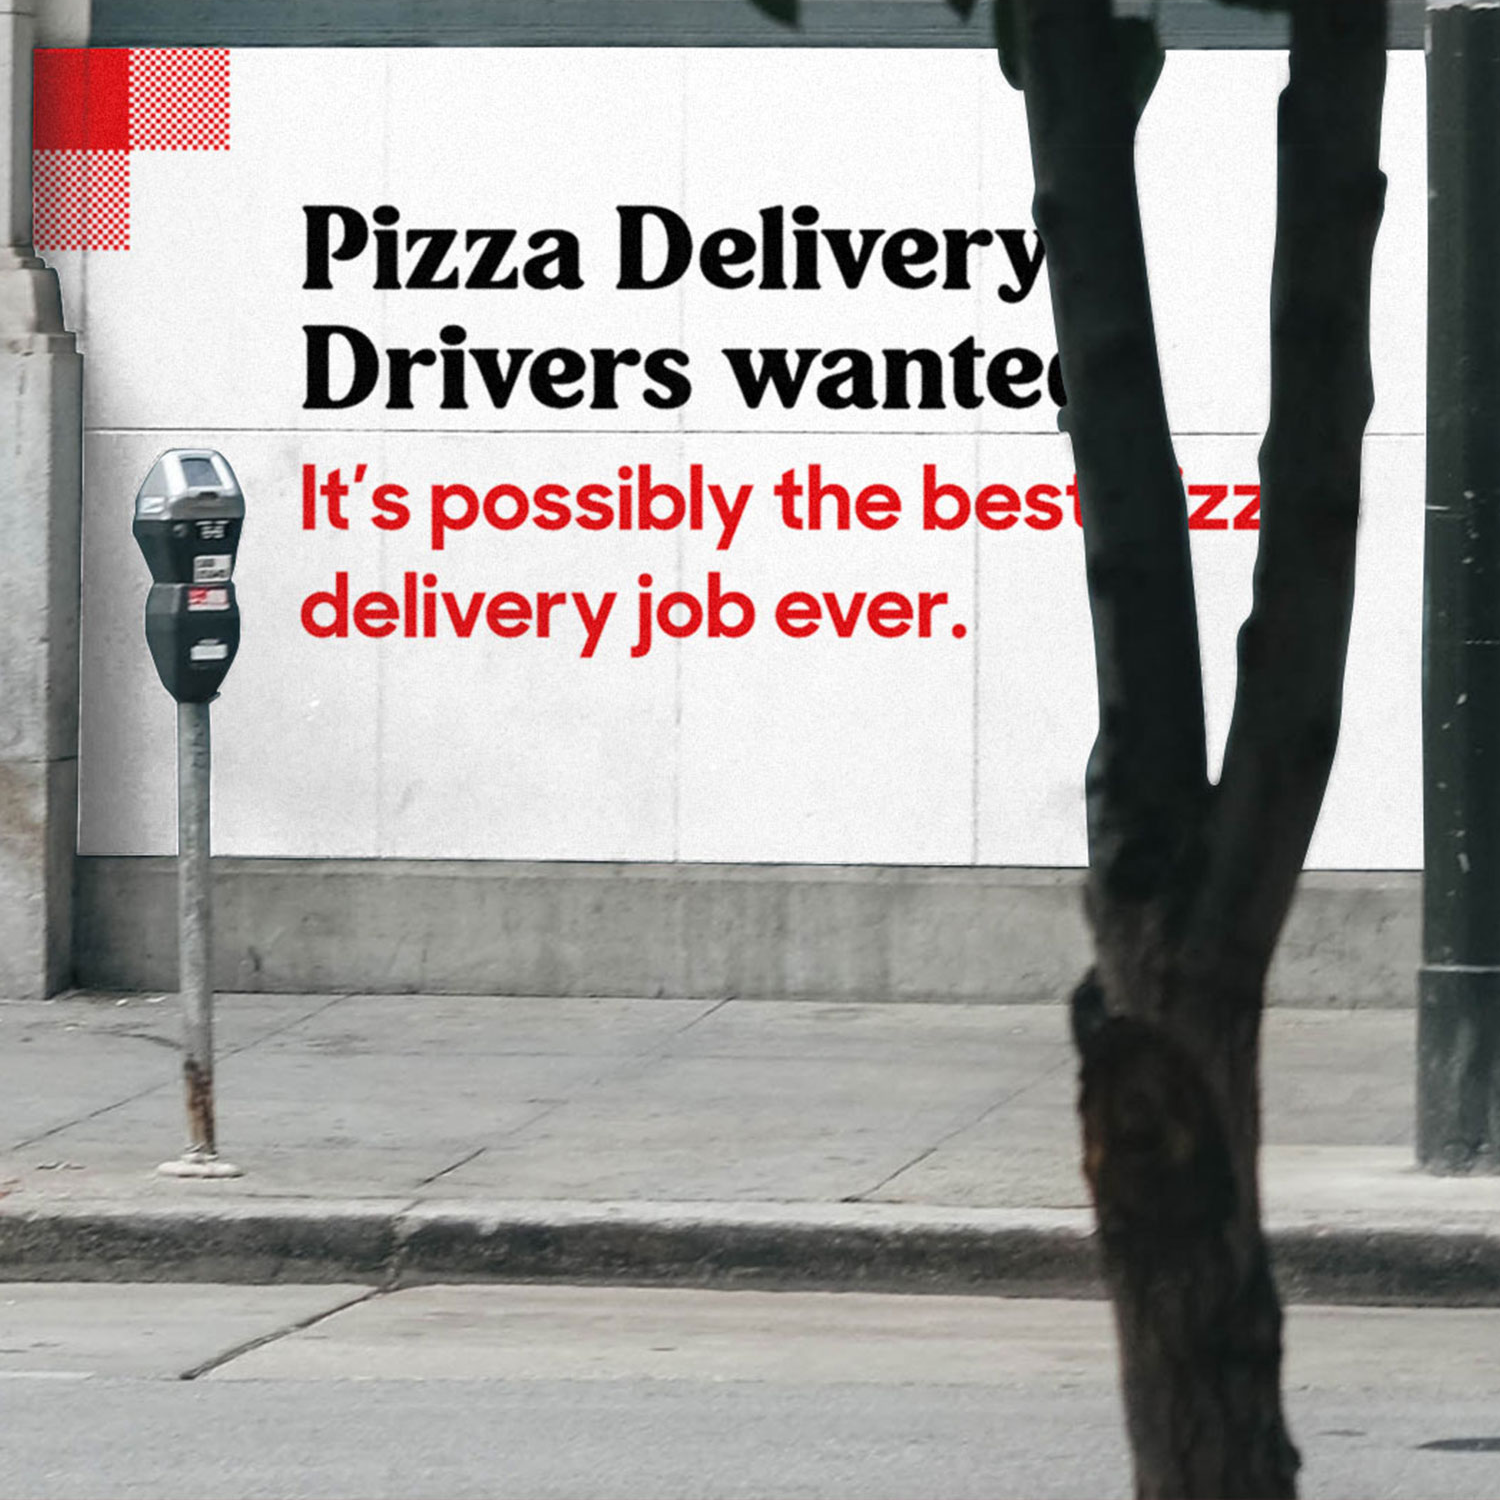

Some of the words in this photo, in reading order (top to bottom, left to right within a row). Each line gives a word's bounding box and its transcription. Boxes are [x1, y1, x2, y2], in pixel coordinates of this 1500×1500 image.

[302, 205, 585, 290] Pizza
[616, 205, 1047, 304] Delivery
[302, 325, 692, 410] Drivers
[301, 463, 411, 531] It's
[431, 463, 753, 551] possibly
[773, 463, 902, 531] the
[923, 463, 1084, 531] best
[300, 571, 617, 658] delivery
[630, 571, 756, 658] job
[775, 591, 967, 639] ever.
